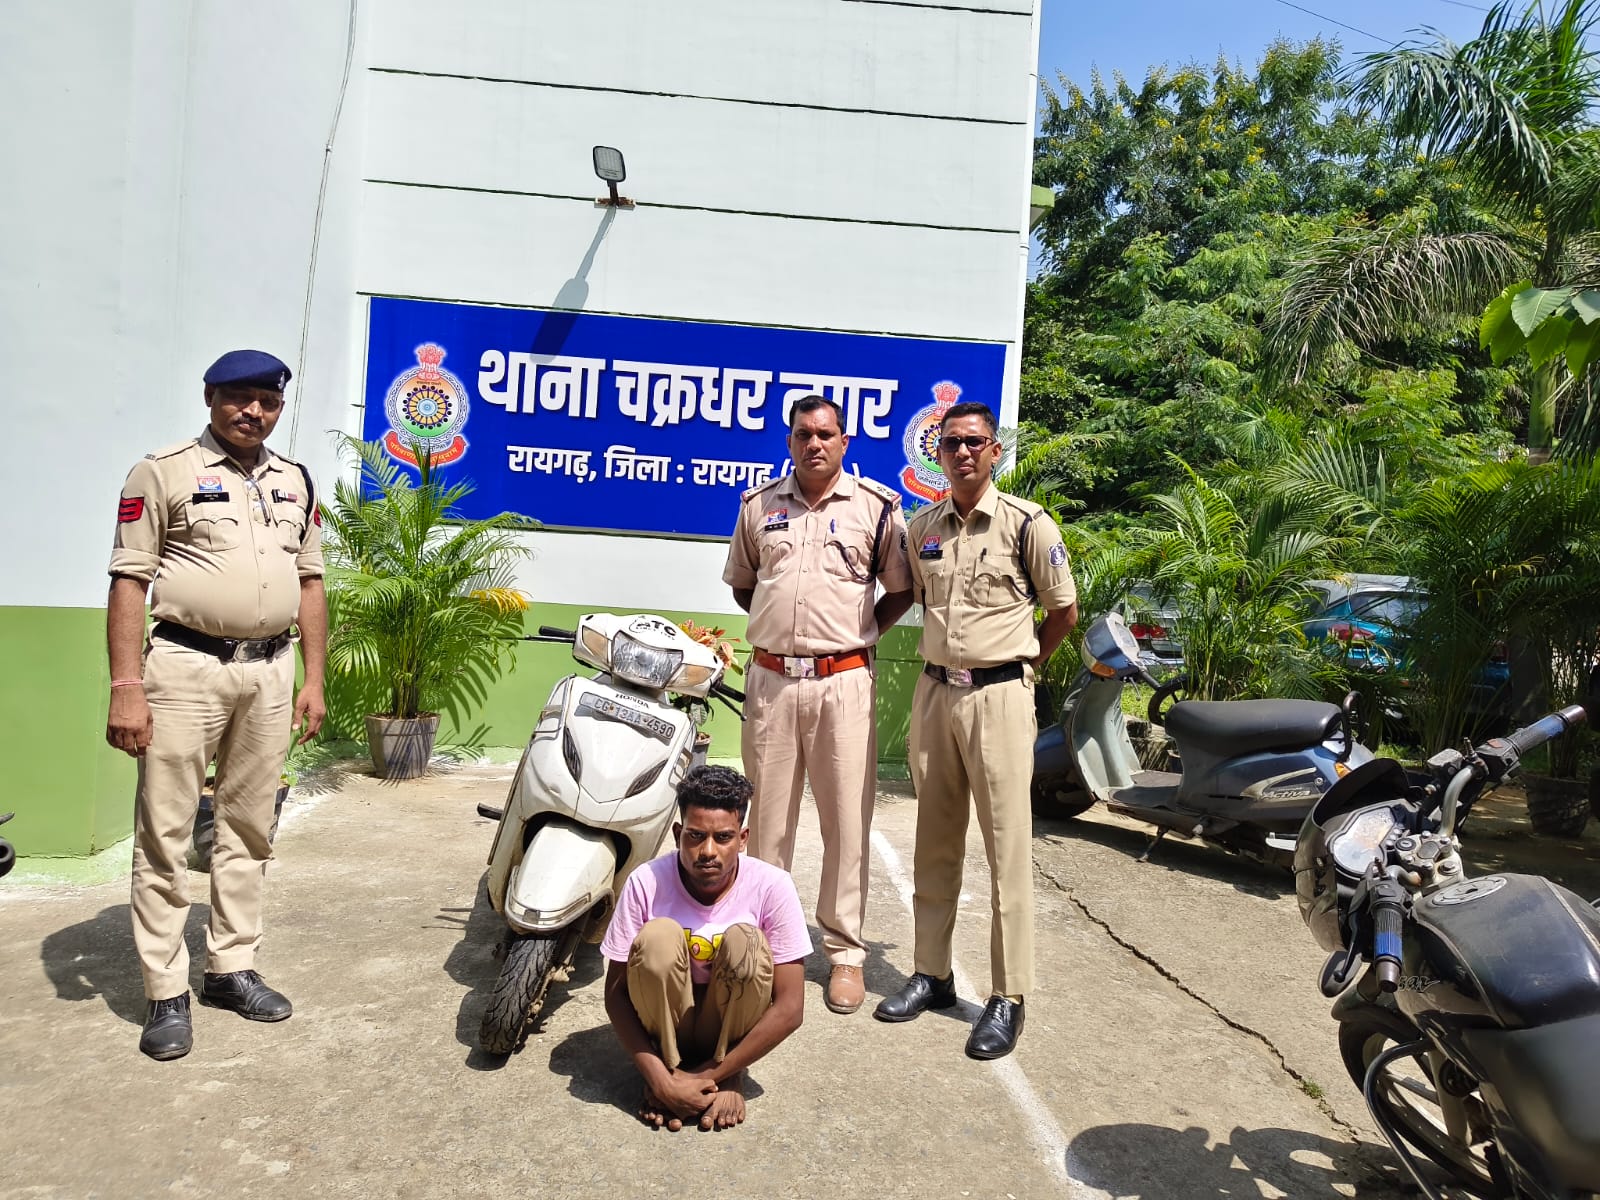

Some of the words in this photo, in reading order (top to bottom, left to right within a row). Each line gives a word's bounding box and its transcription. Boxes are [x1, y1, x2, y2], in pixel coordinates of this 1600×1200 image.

[477, 349, 606, 418] थाना
[612, 359, 773, 430] चक्रधर
[507, 445, 597, 483] रायगढ़,
[603, 444, 671, 482] जिला
[615, 693, 650, 709] HONDA
